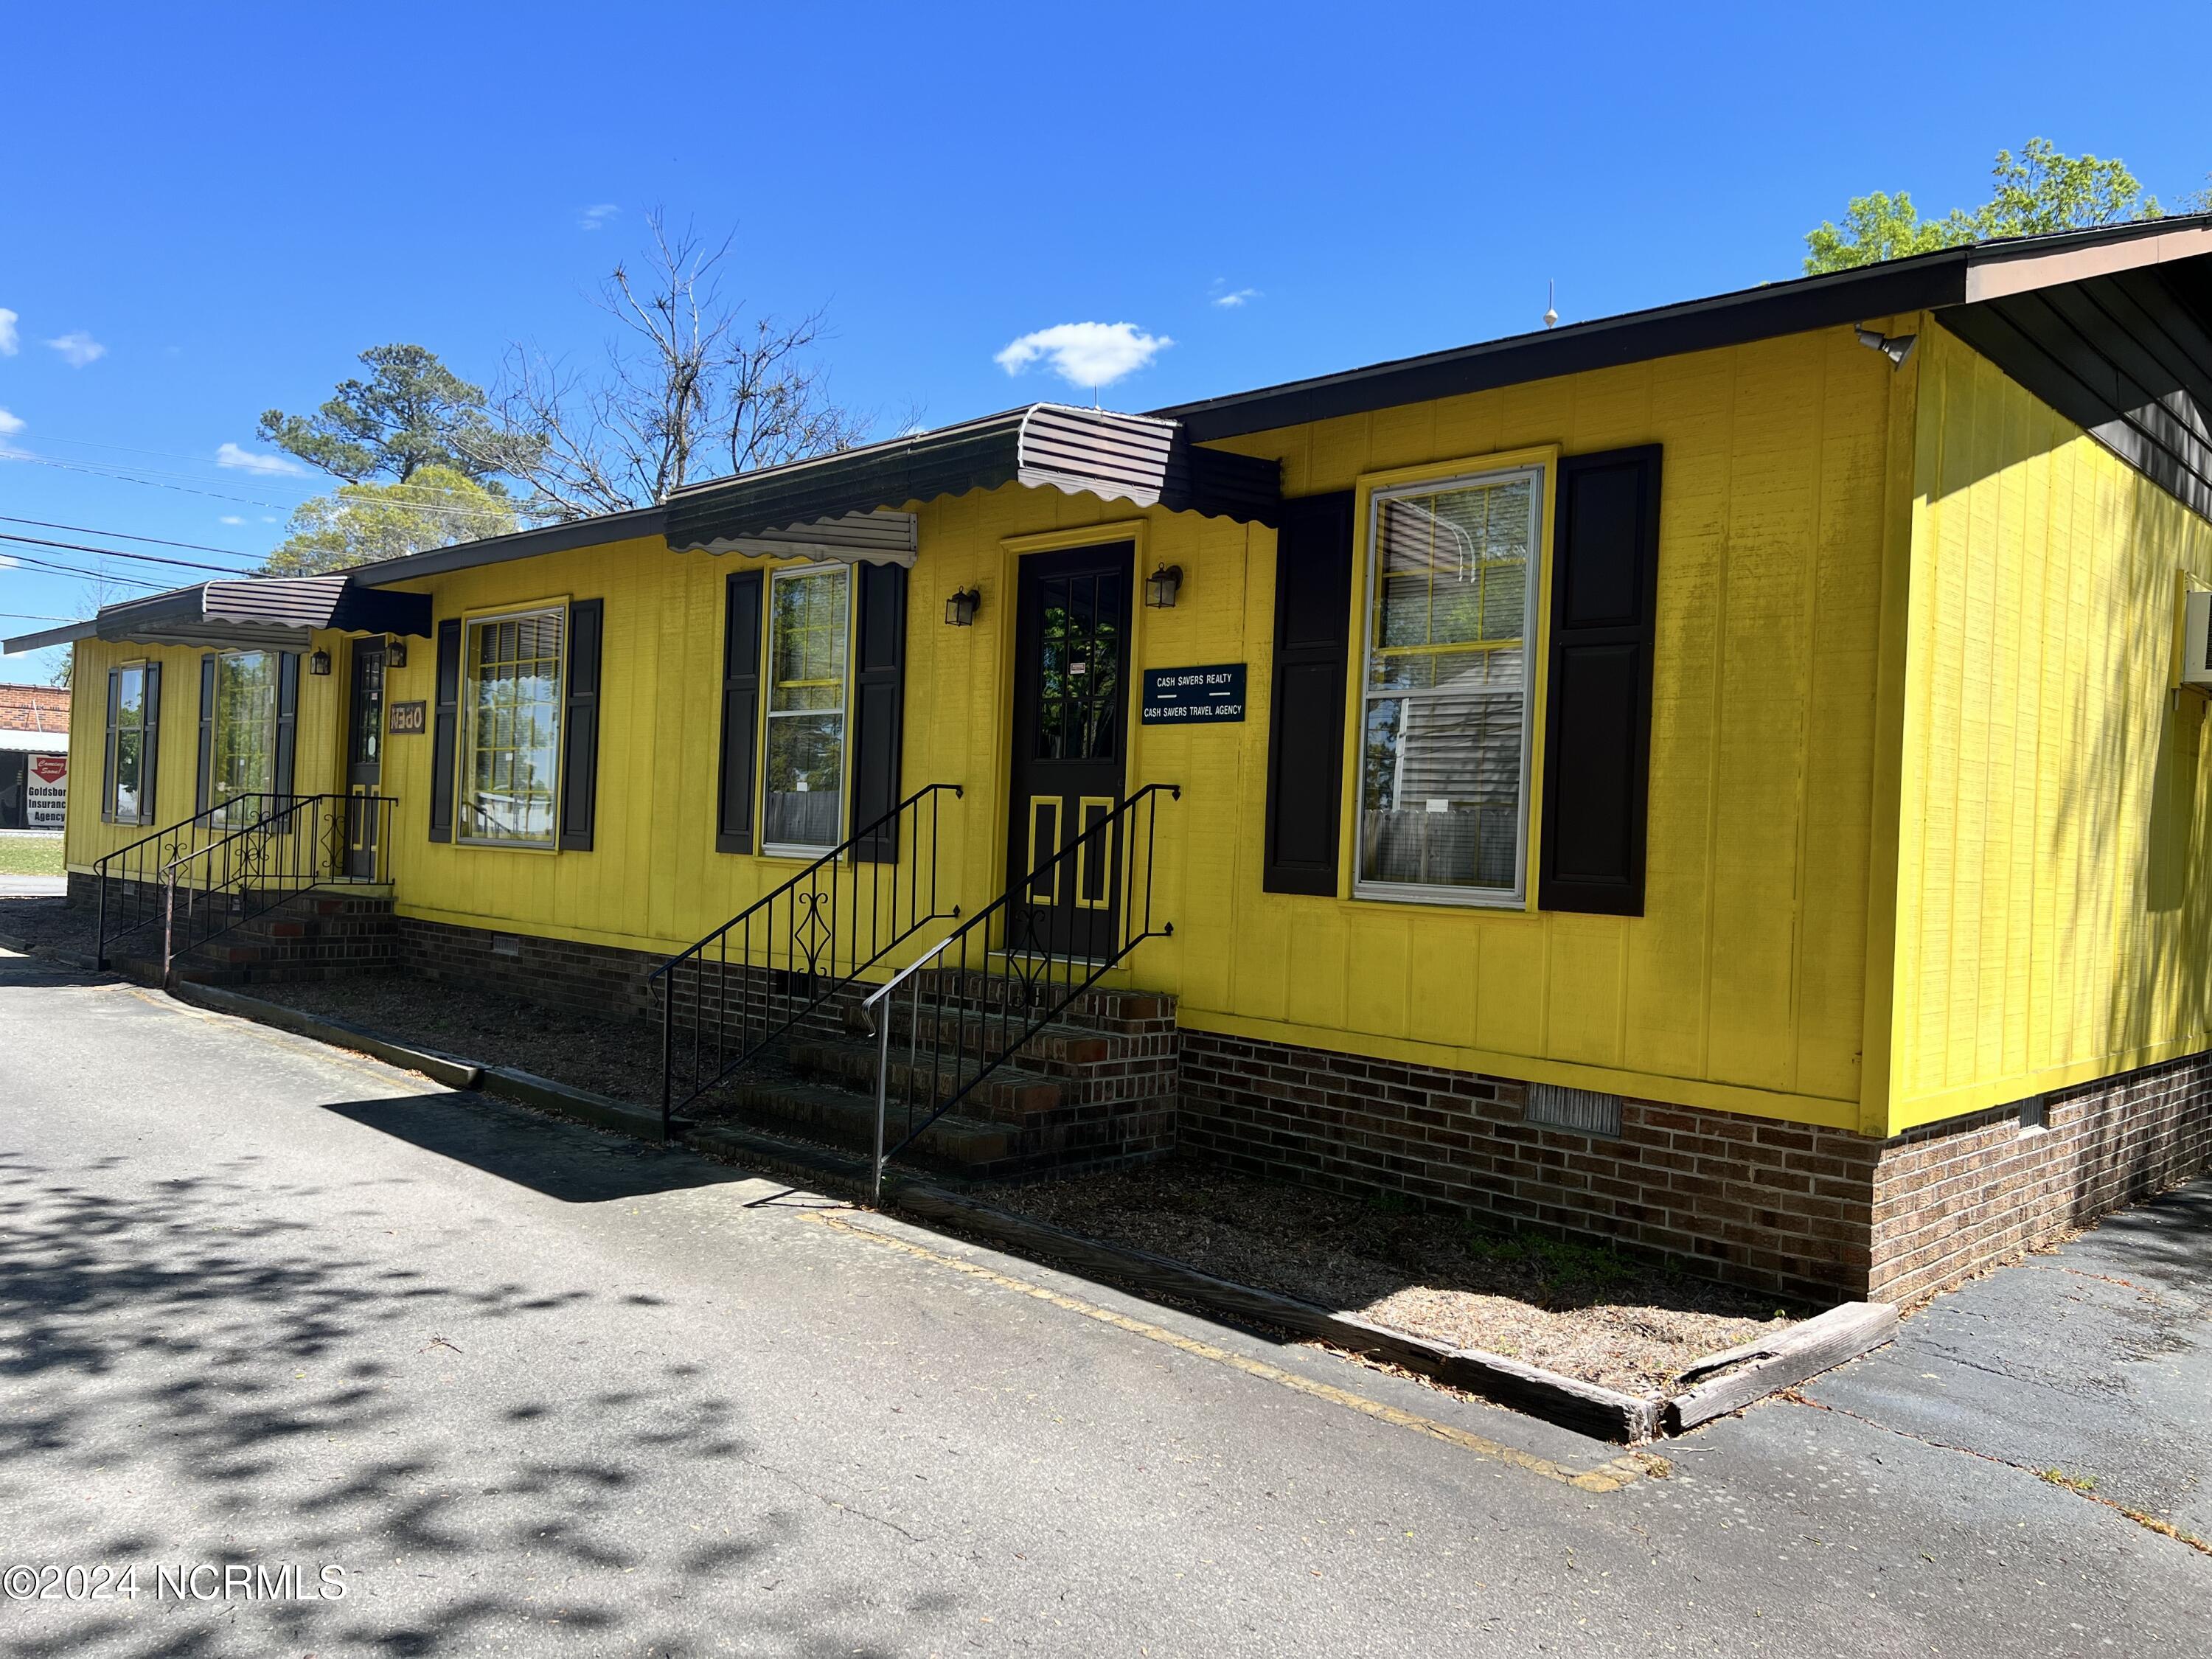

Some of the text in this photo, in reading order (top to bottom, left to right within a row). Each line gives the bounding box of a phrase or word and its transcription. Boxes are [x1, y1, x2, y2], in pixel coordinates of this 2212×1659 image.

[1157, 673, 1232, 687] CASH SAVERS REALTY
[1144, 704, 1242, 717] CASH SAVERS TRAVEL AGENCY
[391, 706, 422, 729] OPEN
[38, 760, 64, 768] Coming
[29, 787, 66, 796] Goldsbor
[29, 799, 66, 809] Insuranc
[35, 812, 65, 821] Agency
